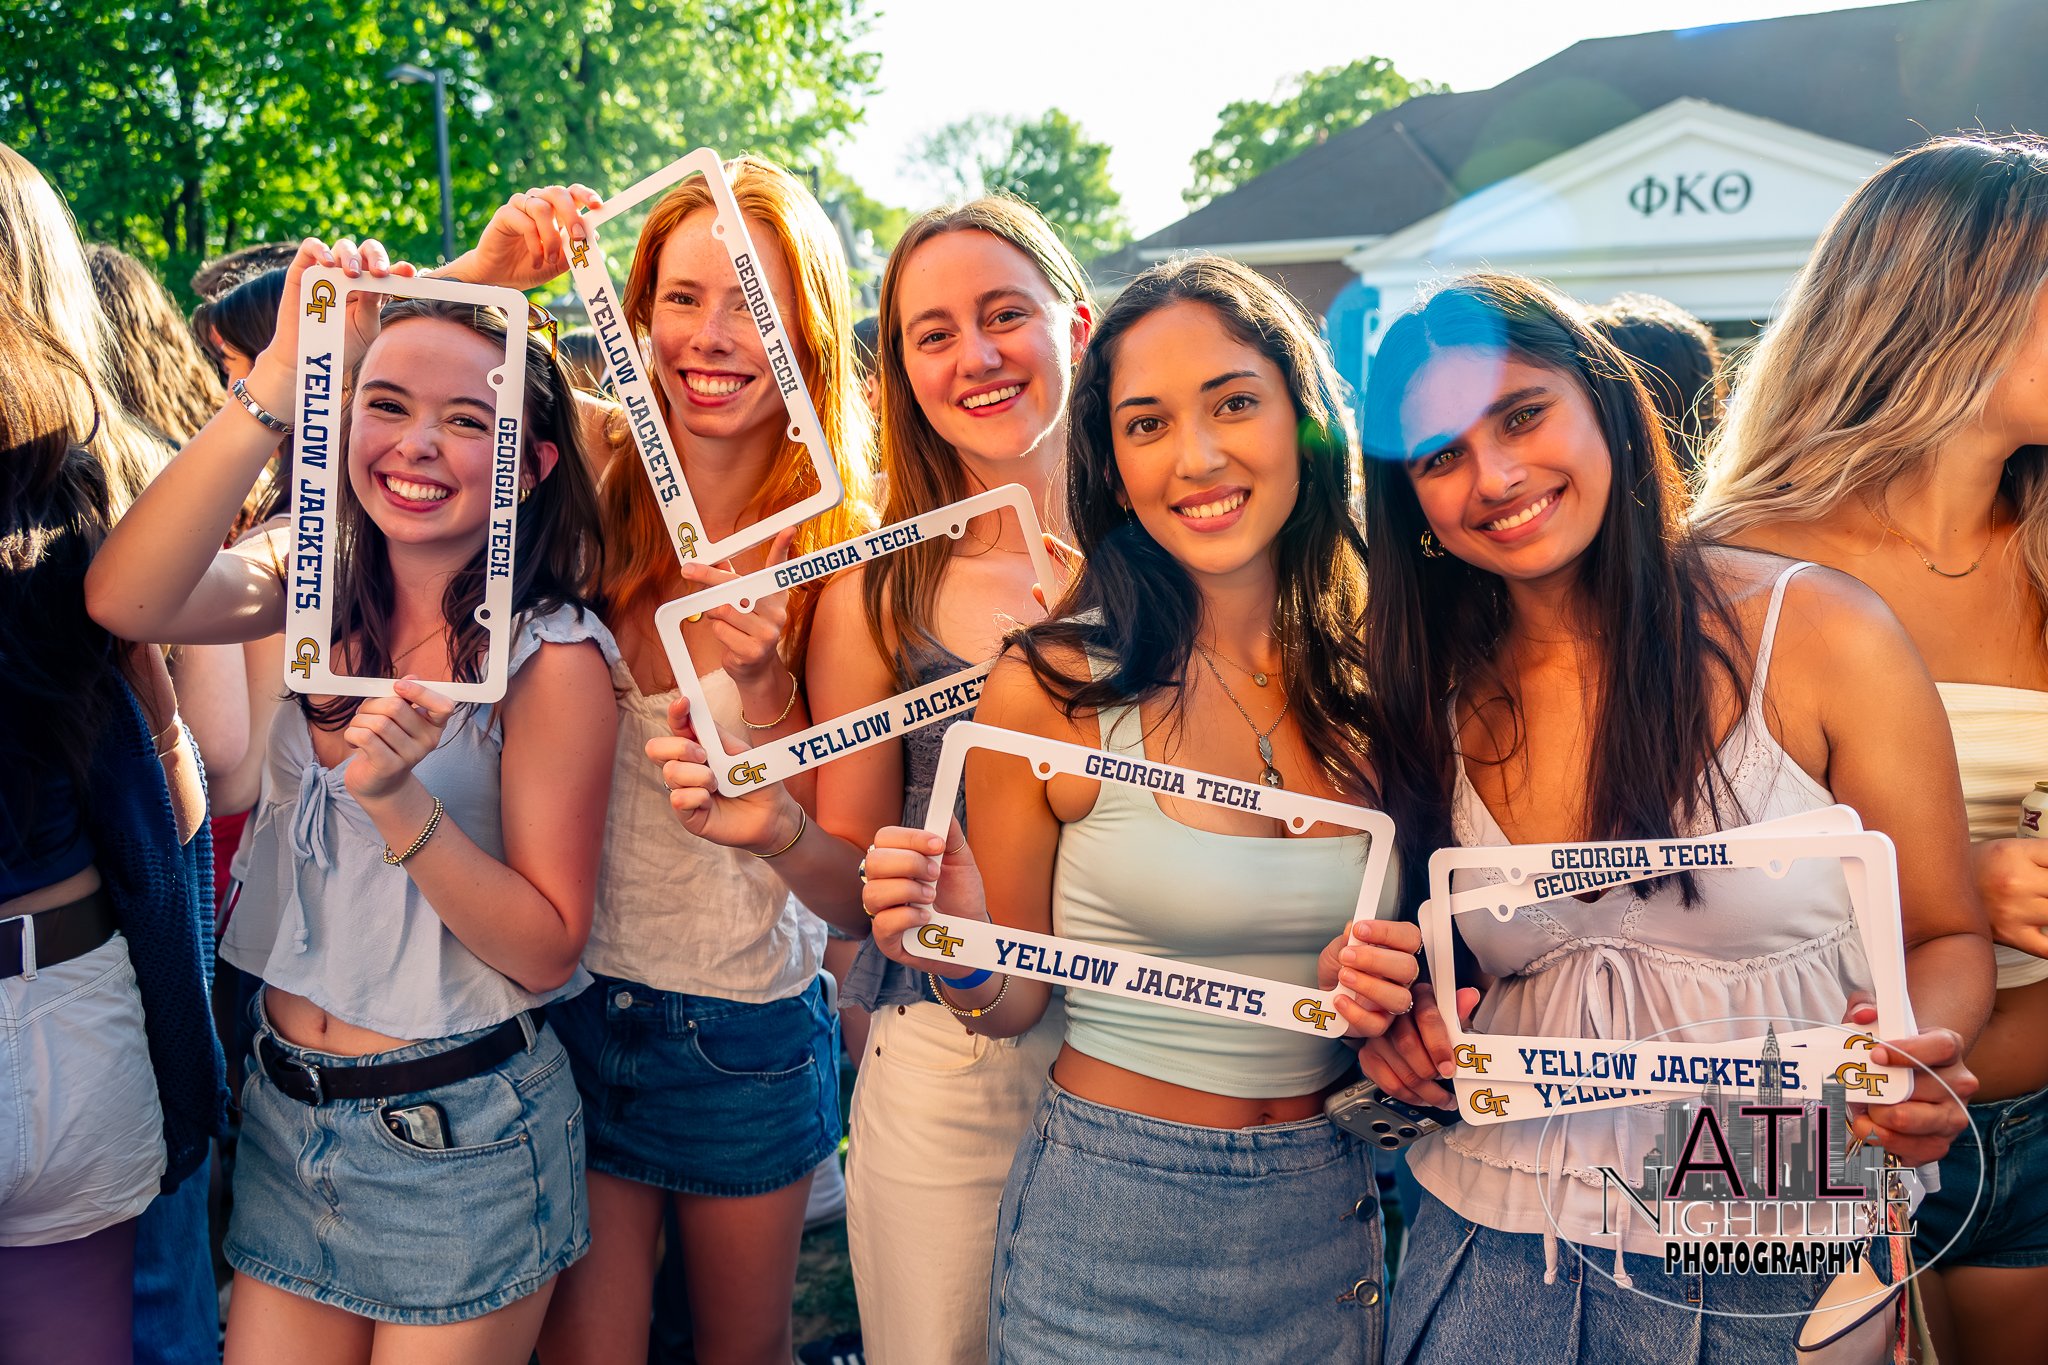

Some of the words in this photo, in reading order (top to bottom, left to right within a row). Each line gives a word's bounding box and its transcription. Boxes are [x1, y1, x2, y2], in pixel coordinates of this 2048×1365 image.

[734, 253, 777, 338] GEORGIA
[588, 286, 638, 386] YELLOW
[301, 352, 332, 470] YELLOW
[494, 417, 518, 510] GEORGIA
[774, 545, 862, 589] GEORGIA
[788, 710, 893, 766] YELLOW
[1085, 754, 1185, 795] GEORGIA
[1551, 846, 1651, 870] GEORGIA
[995, 938, 1119, 987] YELLOW
[1518, 1048, 1638, 1081] YELLOW
